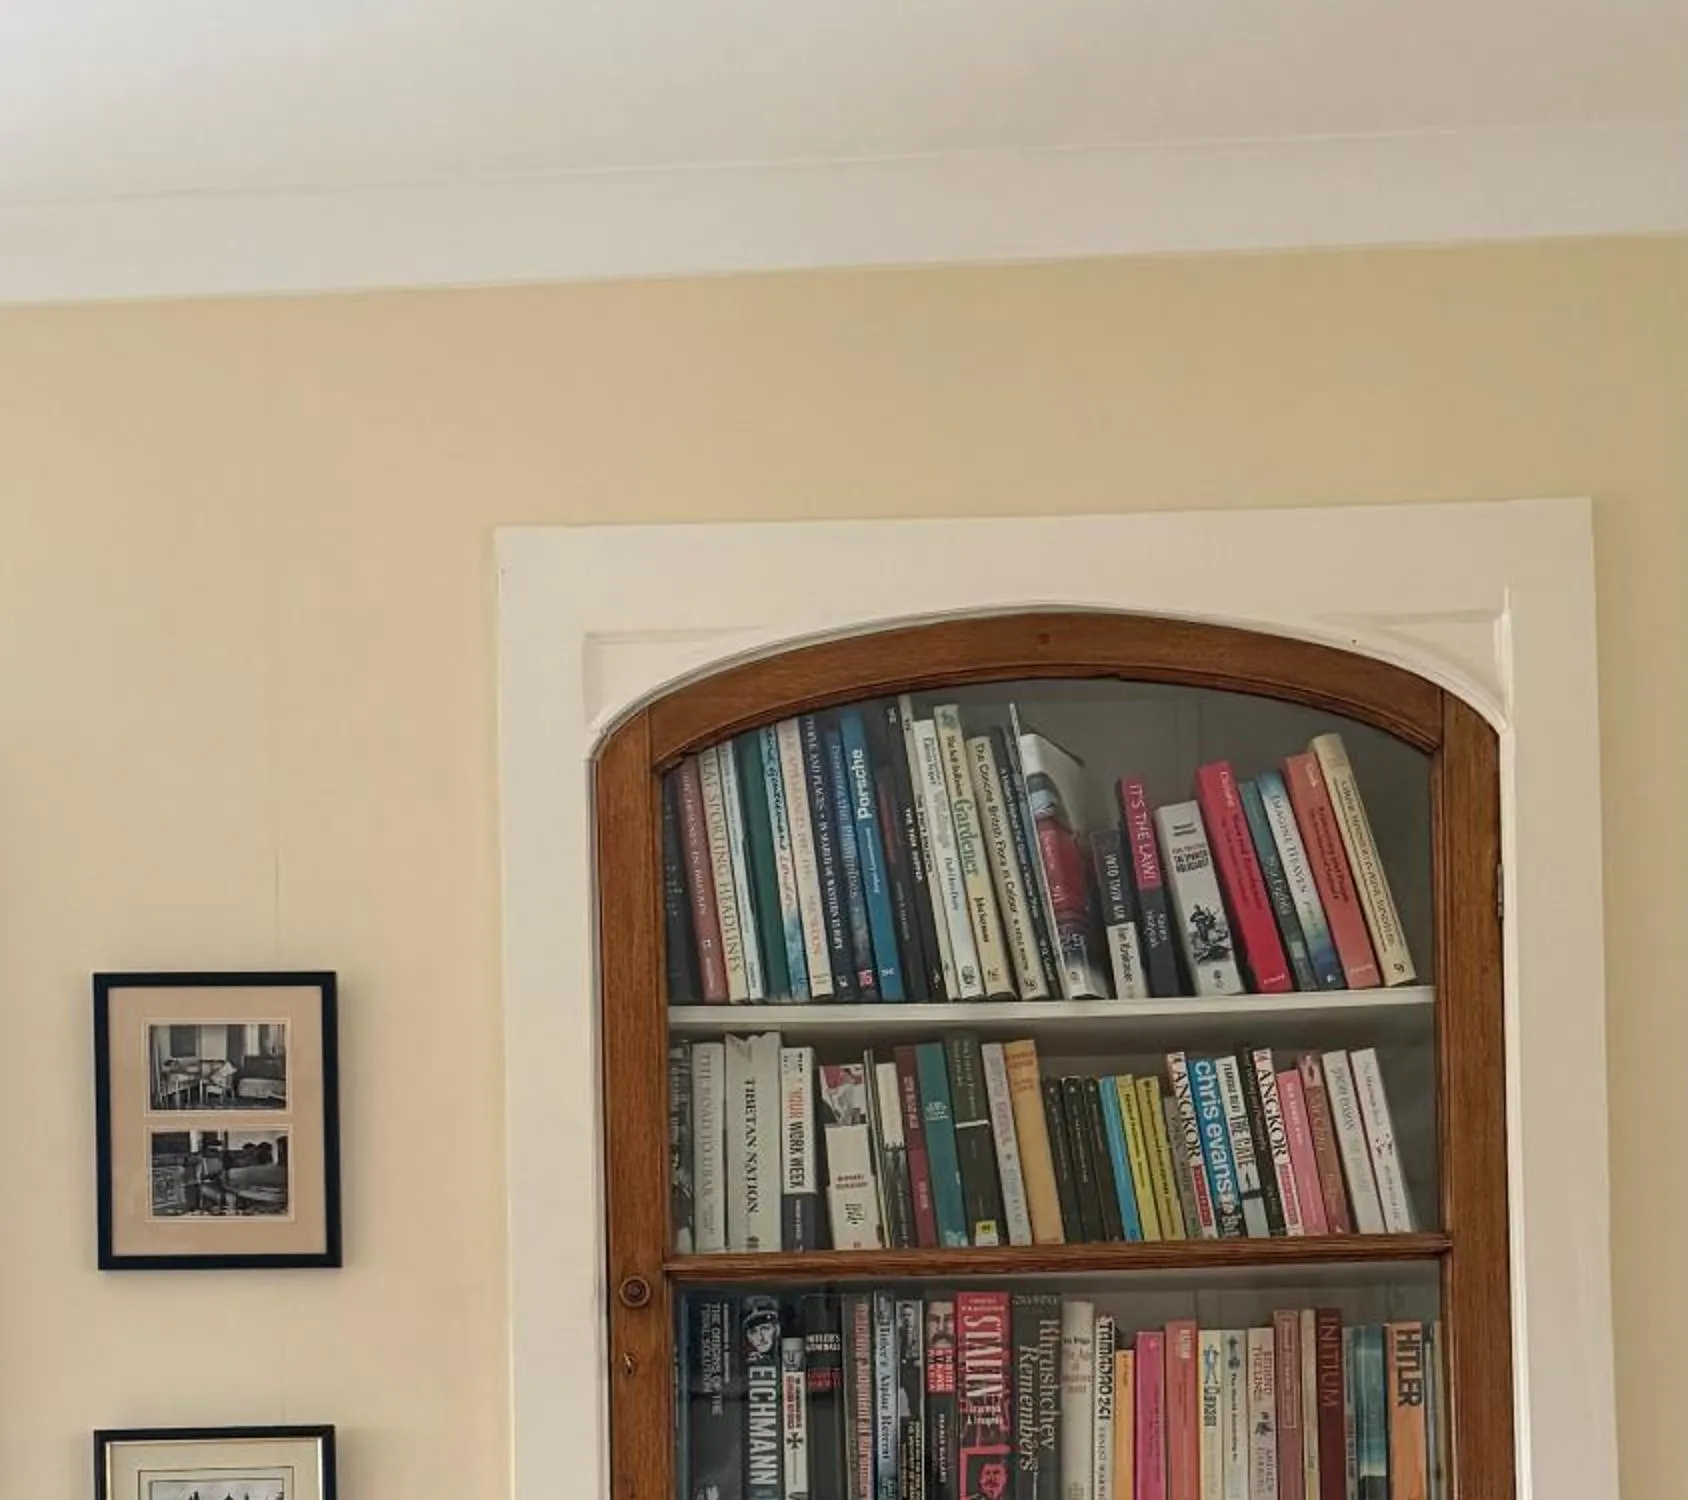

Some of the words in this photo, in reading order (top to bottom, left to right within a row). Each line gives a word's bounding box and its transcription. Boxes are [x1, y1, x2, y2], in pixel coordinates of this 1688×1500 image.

[846, 747, 873, 820] Porsche
[952, 797, 985, 877] Gardener
[1133, 812, 1150, 841] THE
[1137, 841, 1156, 880] LAW!
[744, 1078, 756, 1148] TIBETAN
[1170, 1067, 1202, 1160] ANGKOR
[1192, 1059, 1223, 1121] chris
[1257, 1067, 1288, 1158] ANGKOR
[789, 1121, 804, 1153] WORK
[789, 1156, 805, 1189] WEEK
[1203, 1121, 1235, 1194] evans
[746, 1151, 757, 1214] NATION
[964, 1314, 1003, 1397] STALIN
[1038, 1318, 1060, 1450] Khrushchev
[1319, 1316, 1340, 1407] INITIUM
[1395, 1328, 1422, 1408] HITLER
[747, 1366, 777, 1485] EICHMANN
[1018, 1344, 1039, 1472] Remembers
